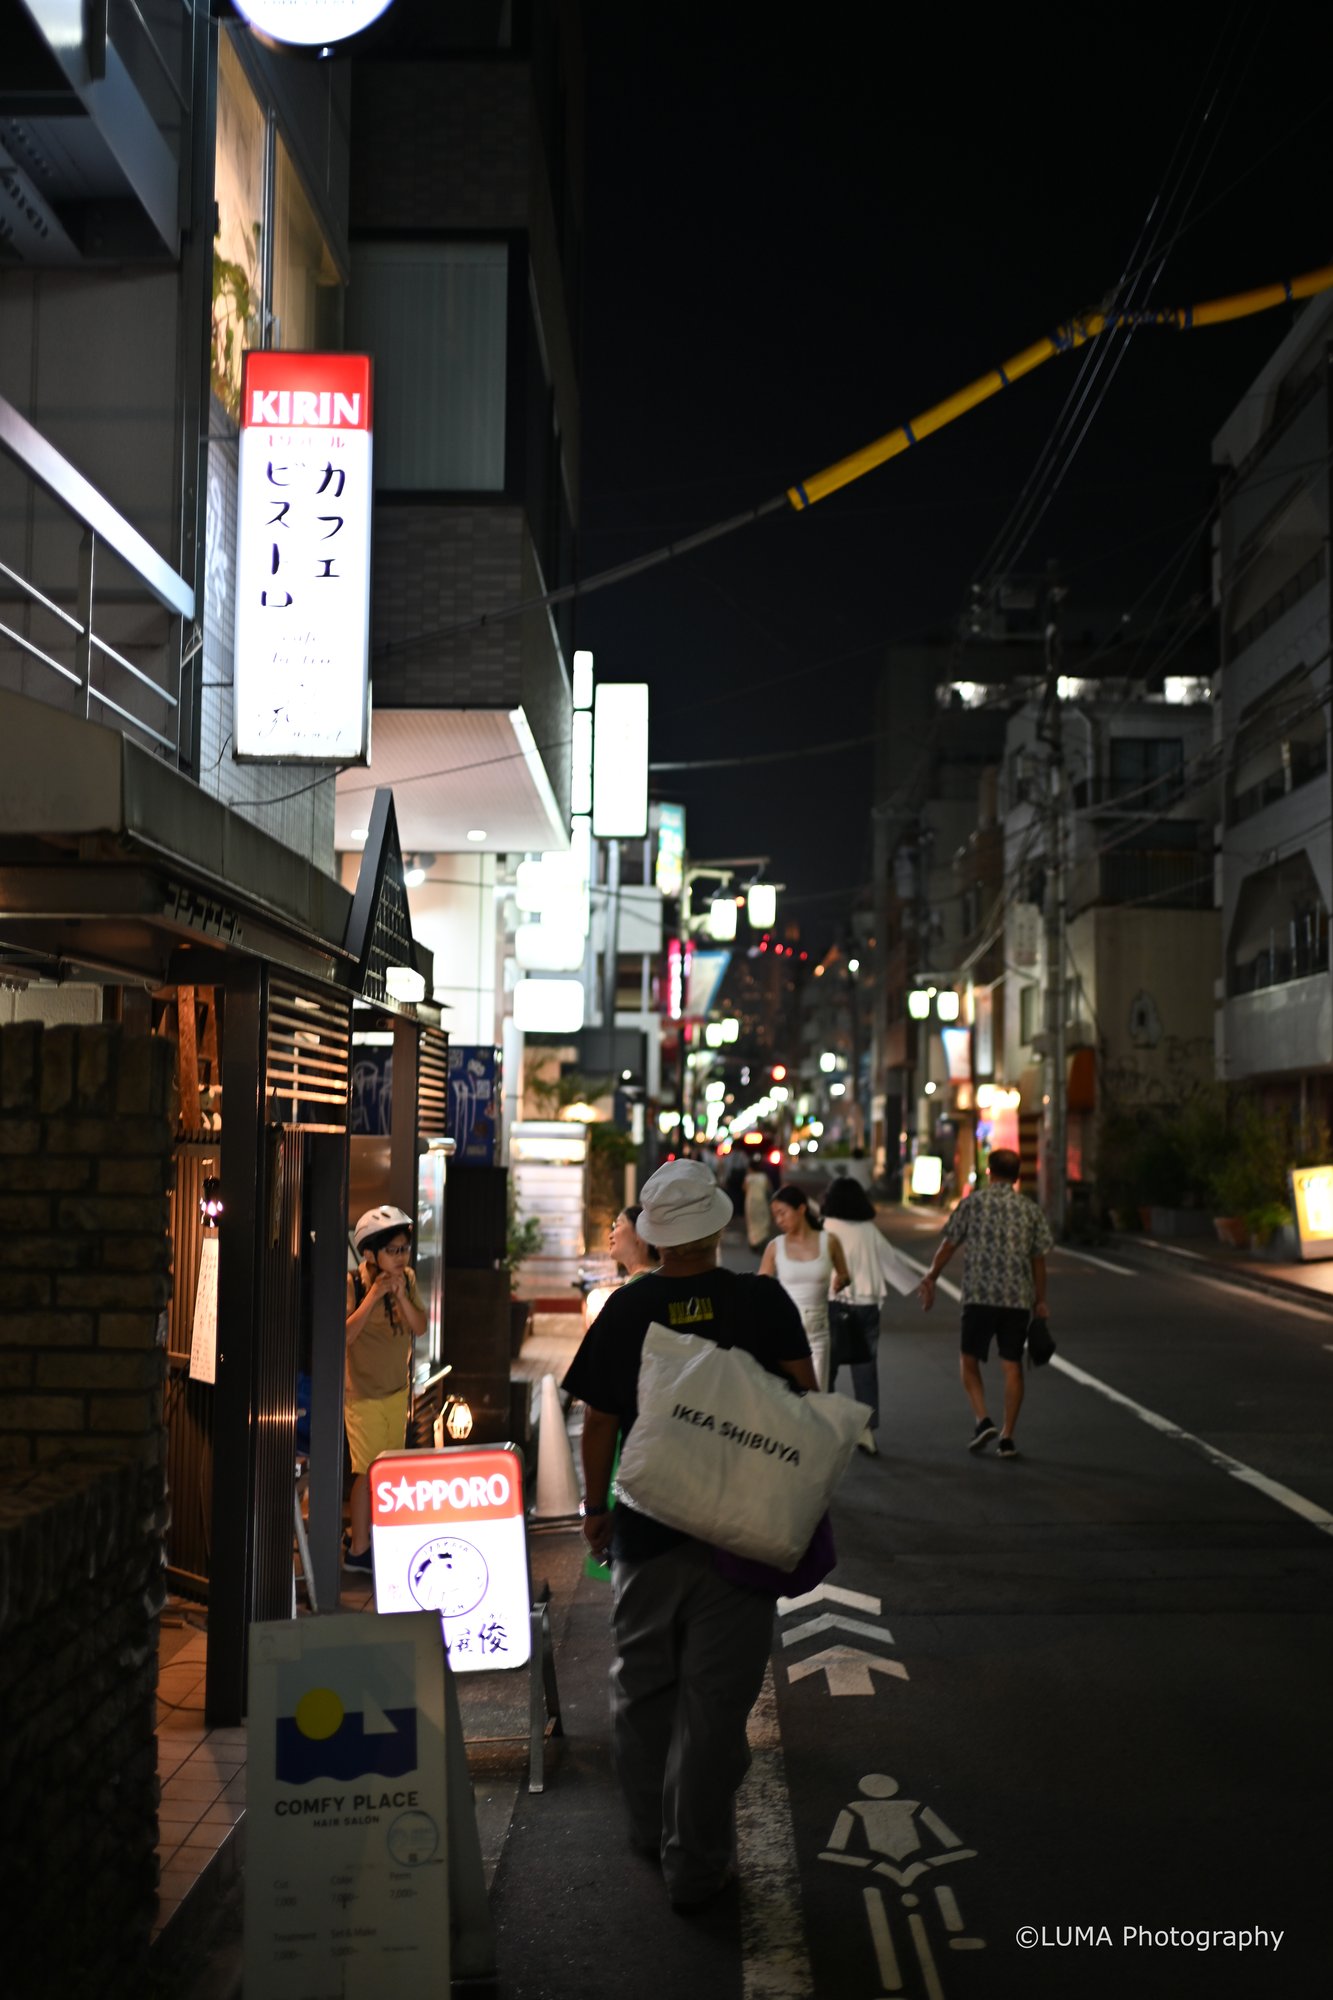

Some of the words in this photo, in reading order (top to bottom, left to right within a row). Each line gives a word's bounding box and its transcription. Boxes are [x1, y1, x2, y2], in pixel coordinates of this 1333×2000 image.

[252, 390, 360, 424] KIRIN
[315, 461, 346, 578] カフェ
[671, 1403, 715, 1431] IKEA
[719, 1421, 802, 1467] SHIBUYA
[274, 1796, 345, 1816] COMFY
[353, 1791, 418, 1810] PLACE
[313, 1818, 339, 1828] HAIR
[344, 1816, 380, 1826] SALON
